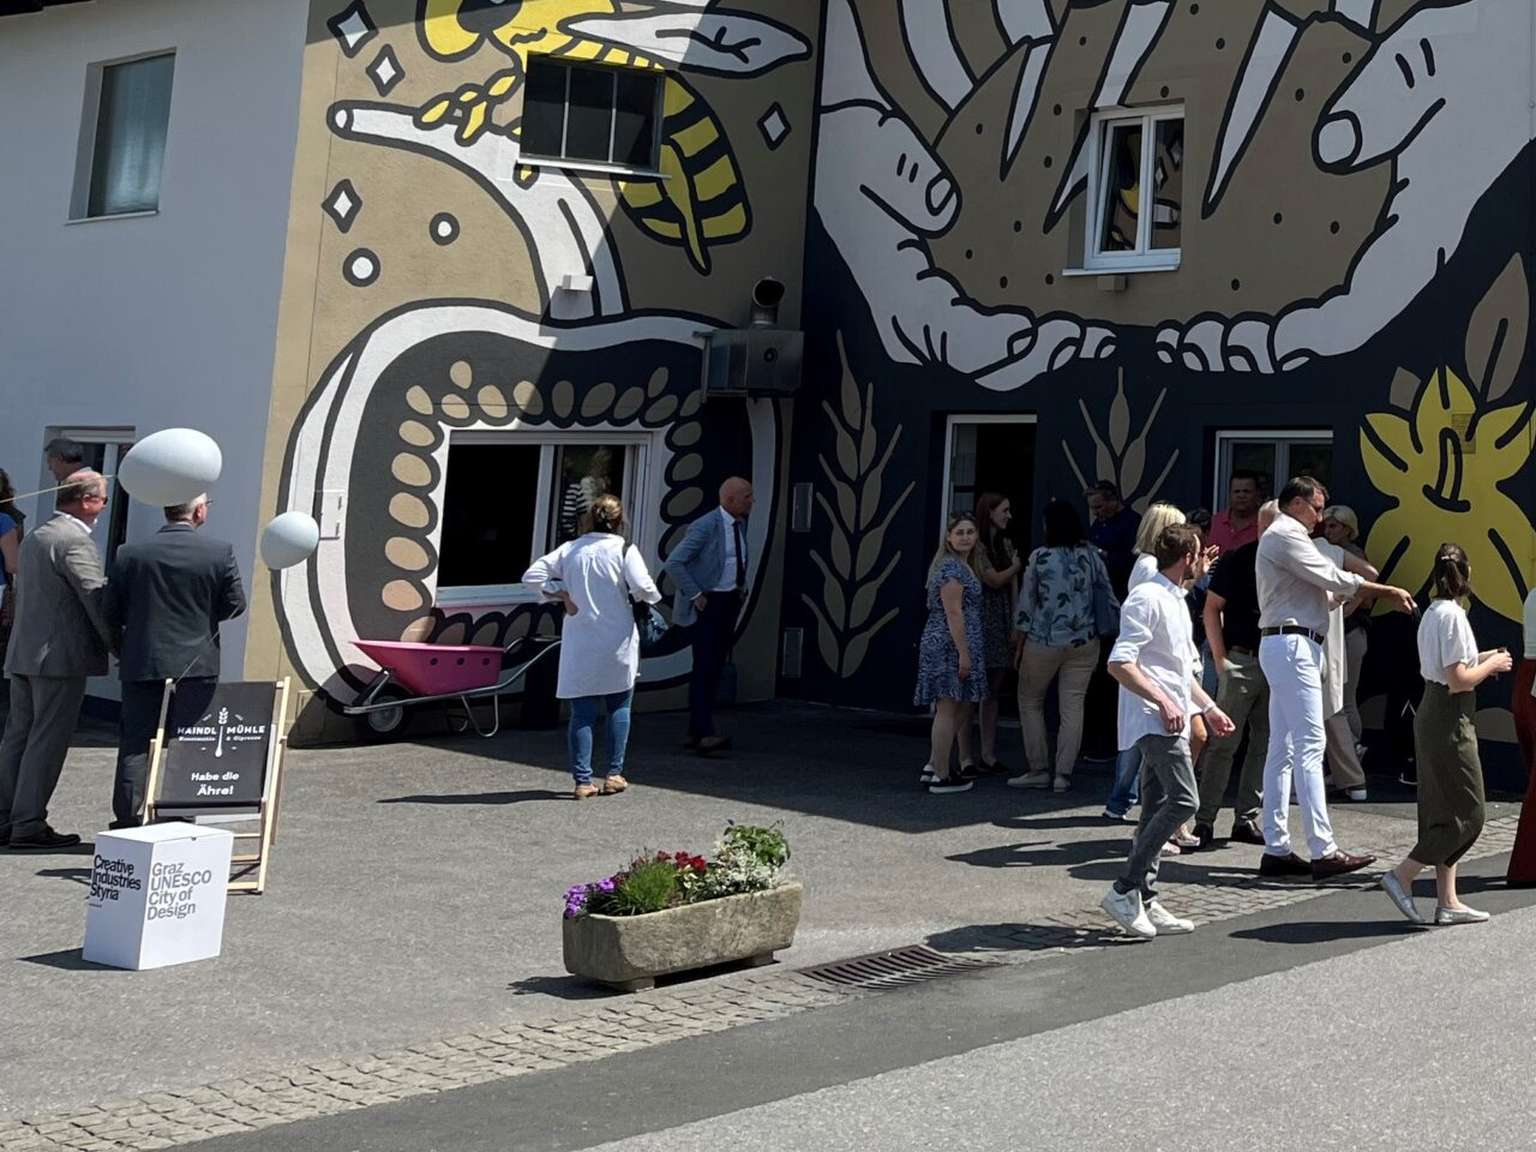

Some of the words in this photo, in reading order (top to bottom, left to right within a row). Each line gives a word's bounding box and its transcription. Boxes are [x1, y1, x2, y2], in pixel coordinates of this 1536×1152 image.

[177, 727, 217, 735] HAINDL
[226, 724, 265, 735] MÜHLE
[191, 772, 220, 781] Habe
[222, 771, 239, 780] die
[197, 784, 234, 796] Ähre!
[94, 854, 135, 874] Creative
[152, 862, 185, 876] Graz
[93, 868, 141, 890] Industries
[151, 870, 212, 890] UNESCO
[90, 882, 119, 901] Styria
[149, 890, 177, 905] City
[178, 886, 193, 901] of
[147, 903, 196, 920] Design
